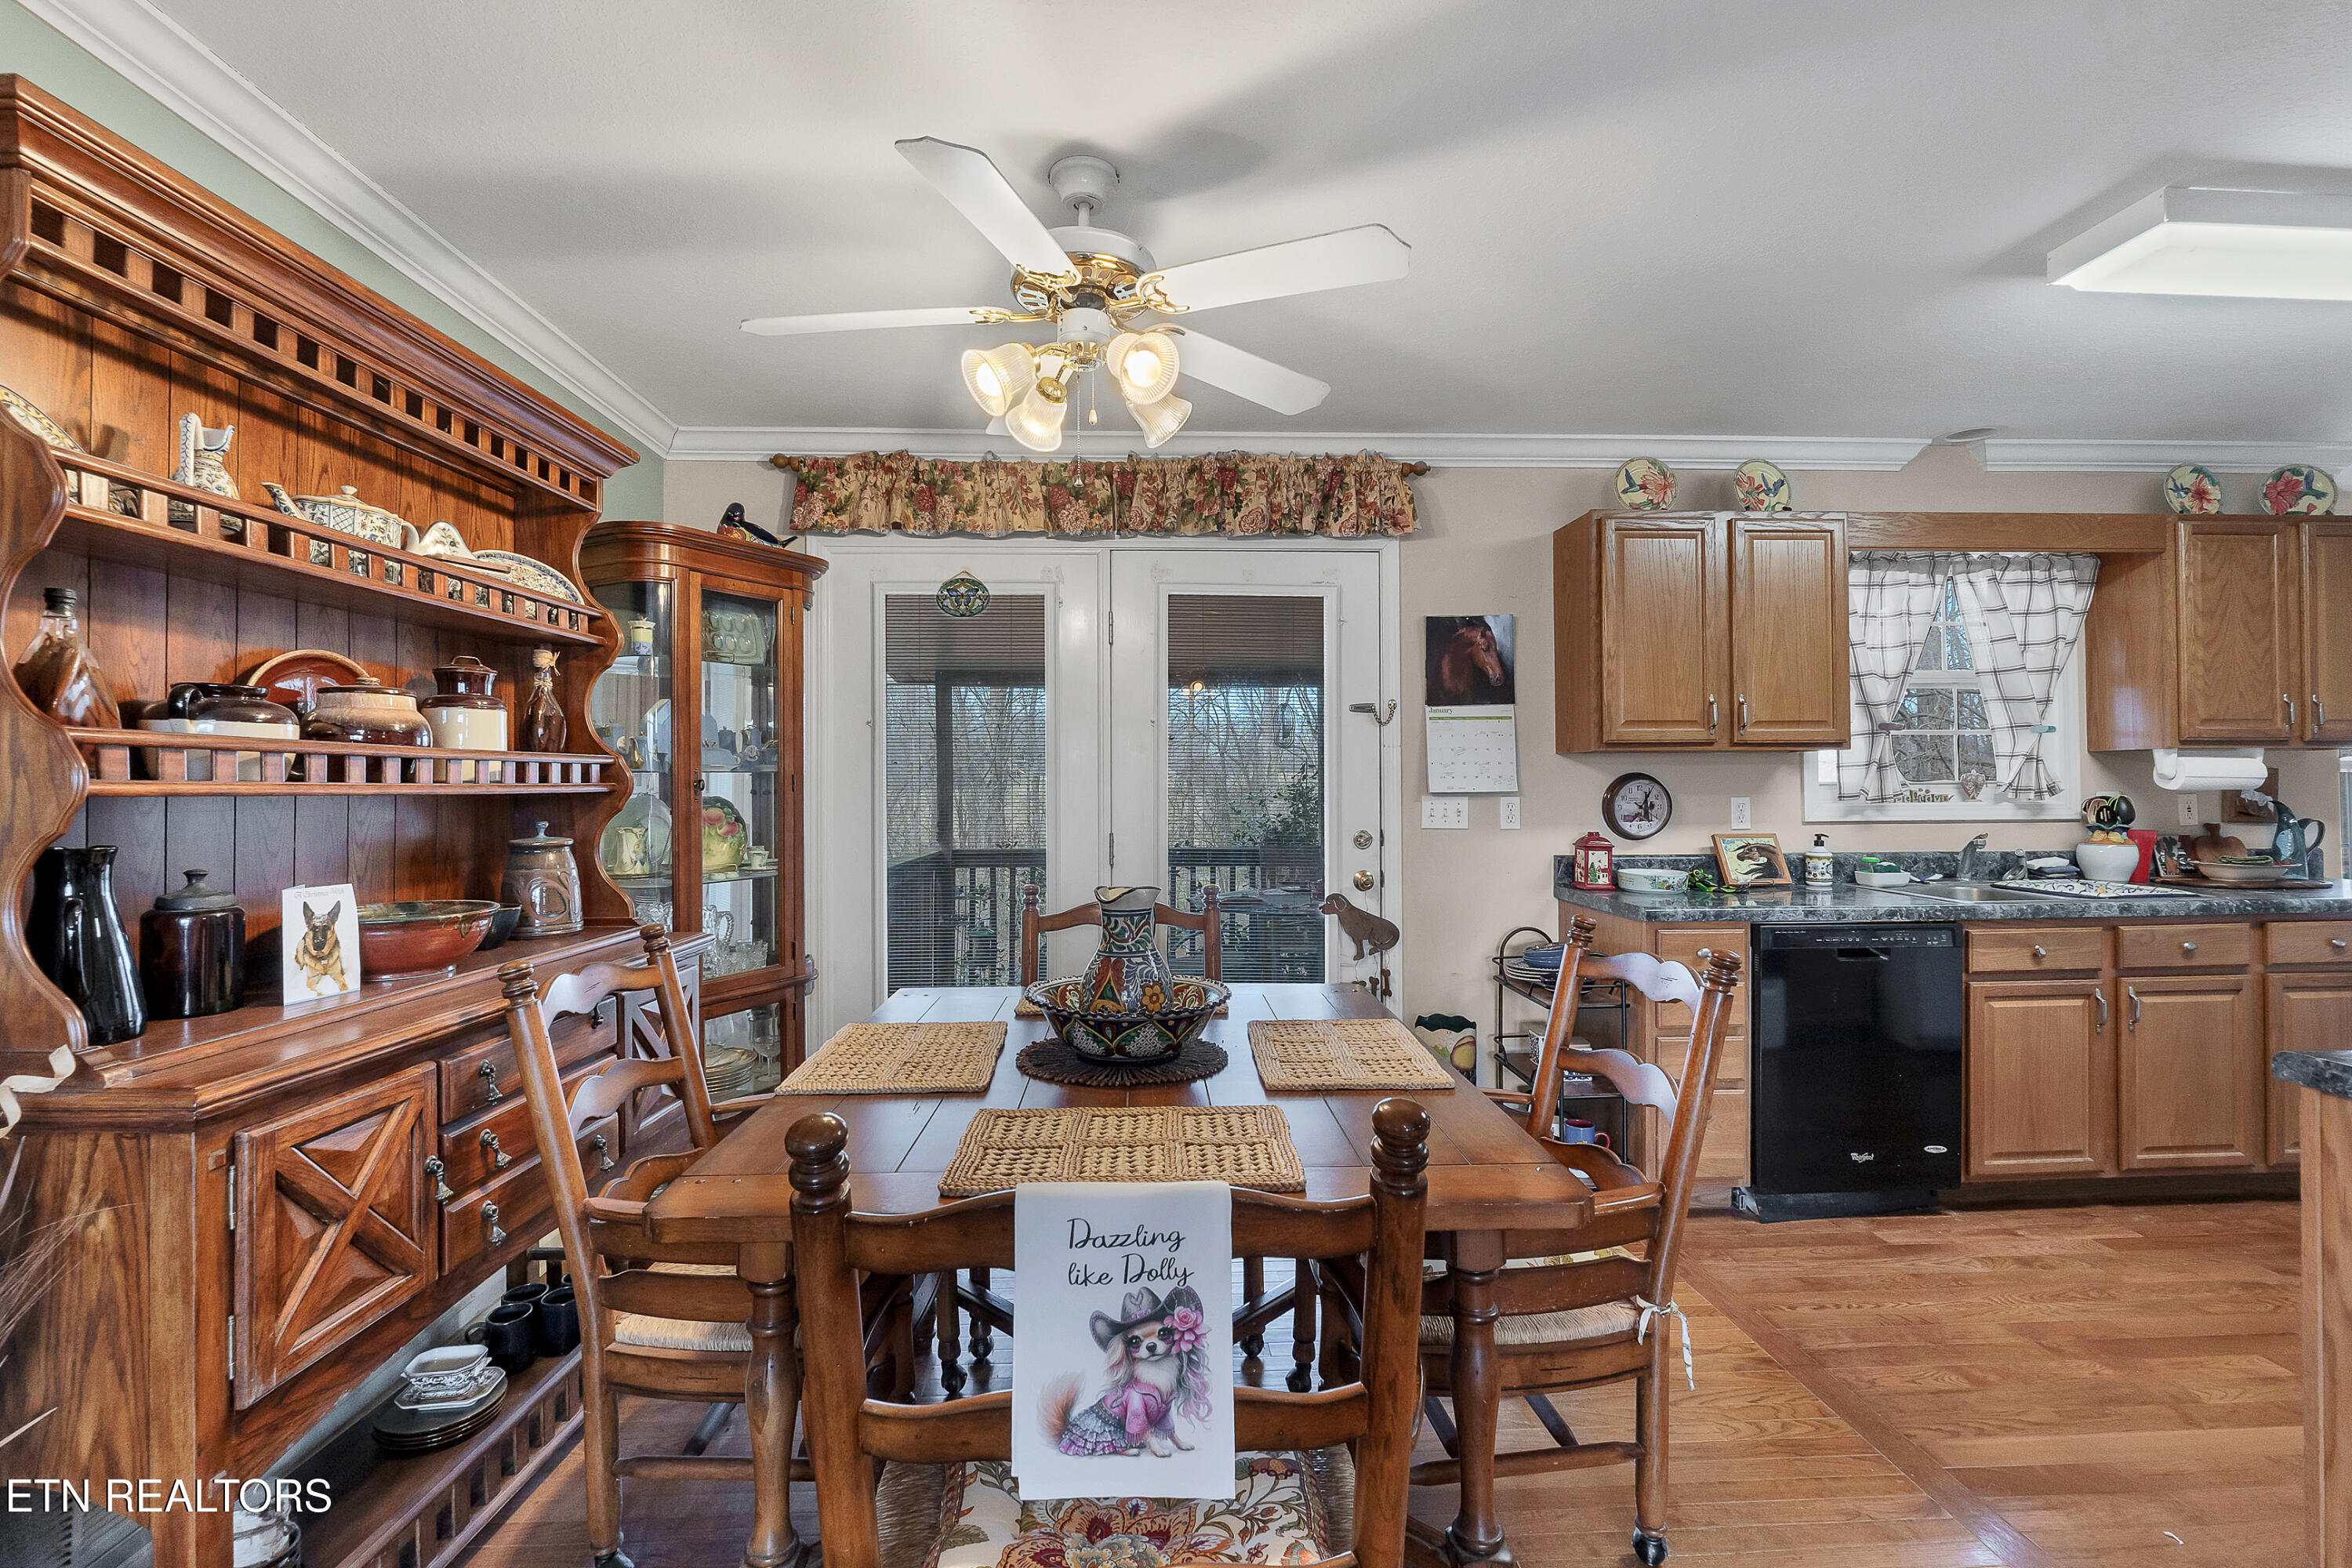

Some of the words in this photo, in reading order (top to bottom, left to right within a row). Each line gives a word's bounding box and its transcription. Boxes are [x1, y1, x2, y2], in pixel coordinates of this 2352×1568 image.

[1067, 1218, 1185, 1252] Dazzling
[1068, 1262, 1113, 1287] like
[1121, 1253, 1195, 1287] Dolly
